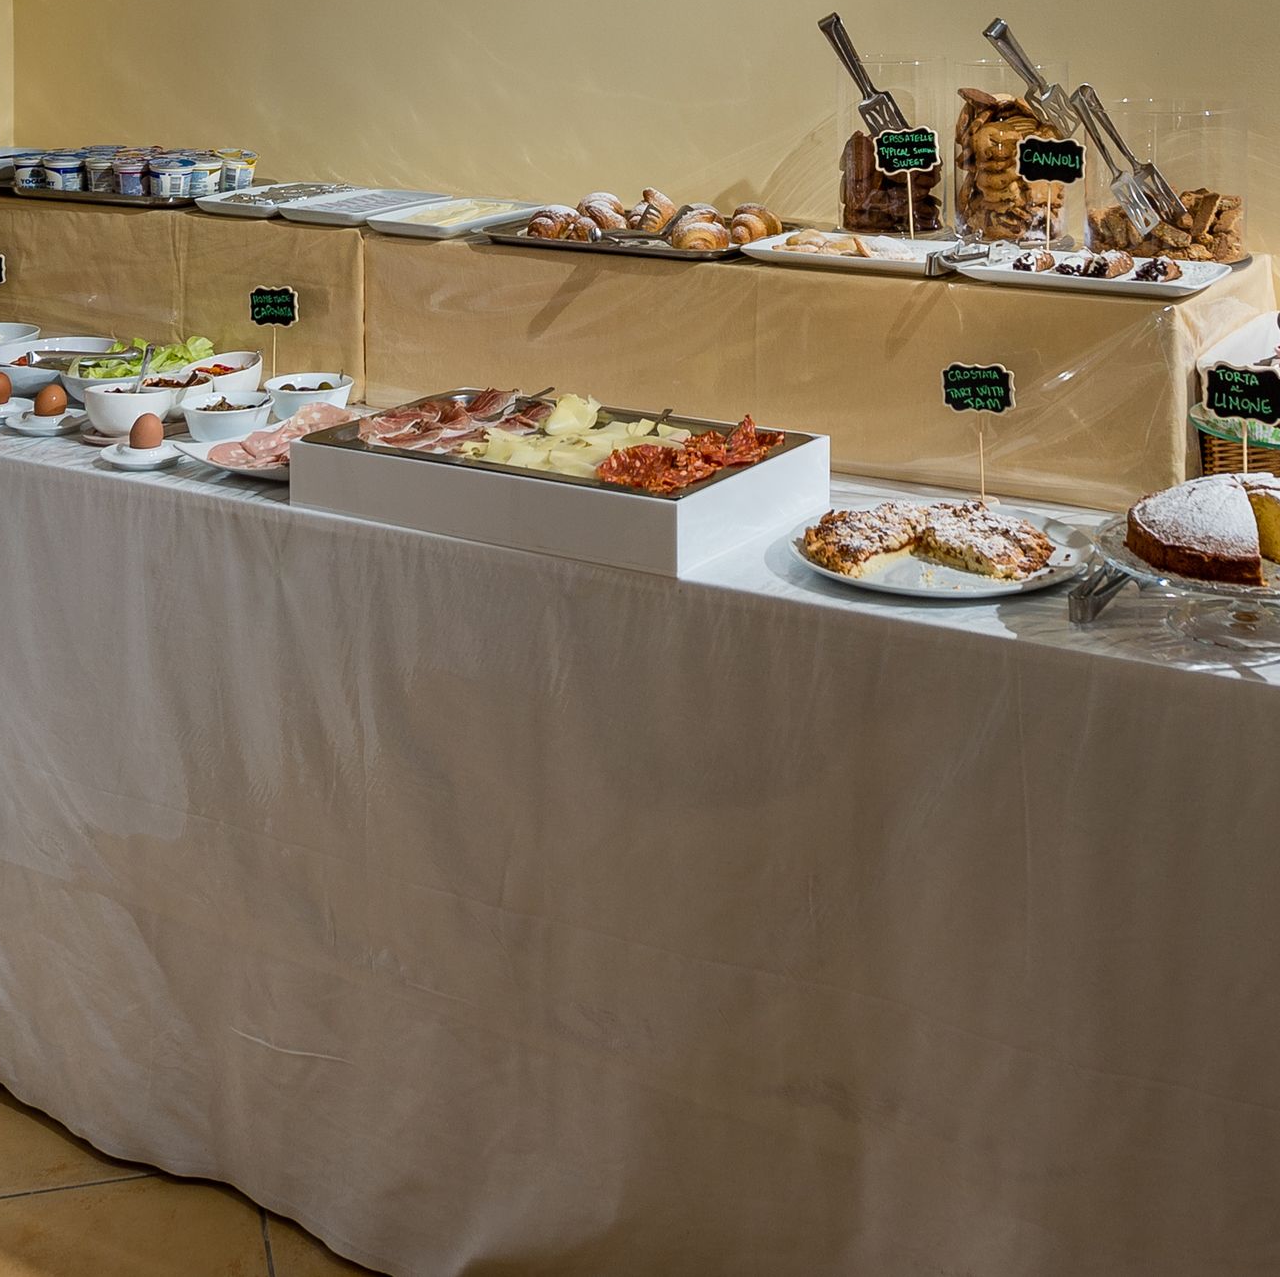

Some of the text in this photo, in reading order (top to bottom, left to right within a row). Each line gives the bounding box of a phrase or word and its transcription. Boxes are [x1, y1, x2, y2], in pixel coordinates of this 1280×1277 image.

[880, 147, 910, 159] TYPICAL
[1023, 149, 1080, 169] CANNOLI
[893, 158, 925, 167] SWEET
[948, 370, 999, 381] CROSTATA
[1216, 369, 1259, 386] TORTA
[946, 385, 1004, 398] TART WITH
[963, 397, 1001, 409] JAM
[1214, 392, 1272, 414] LIMONE
